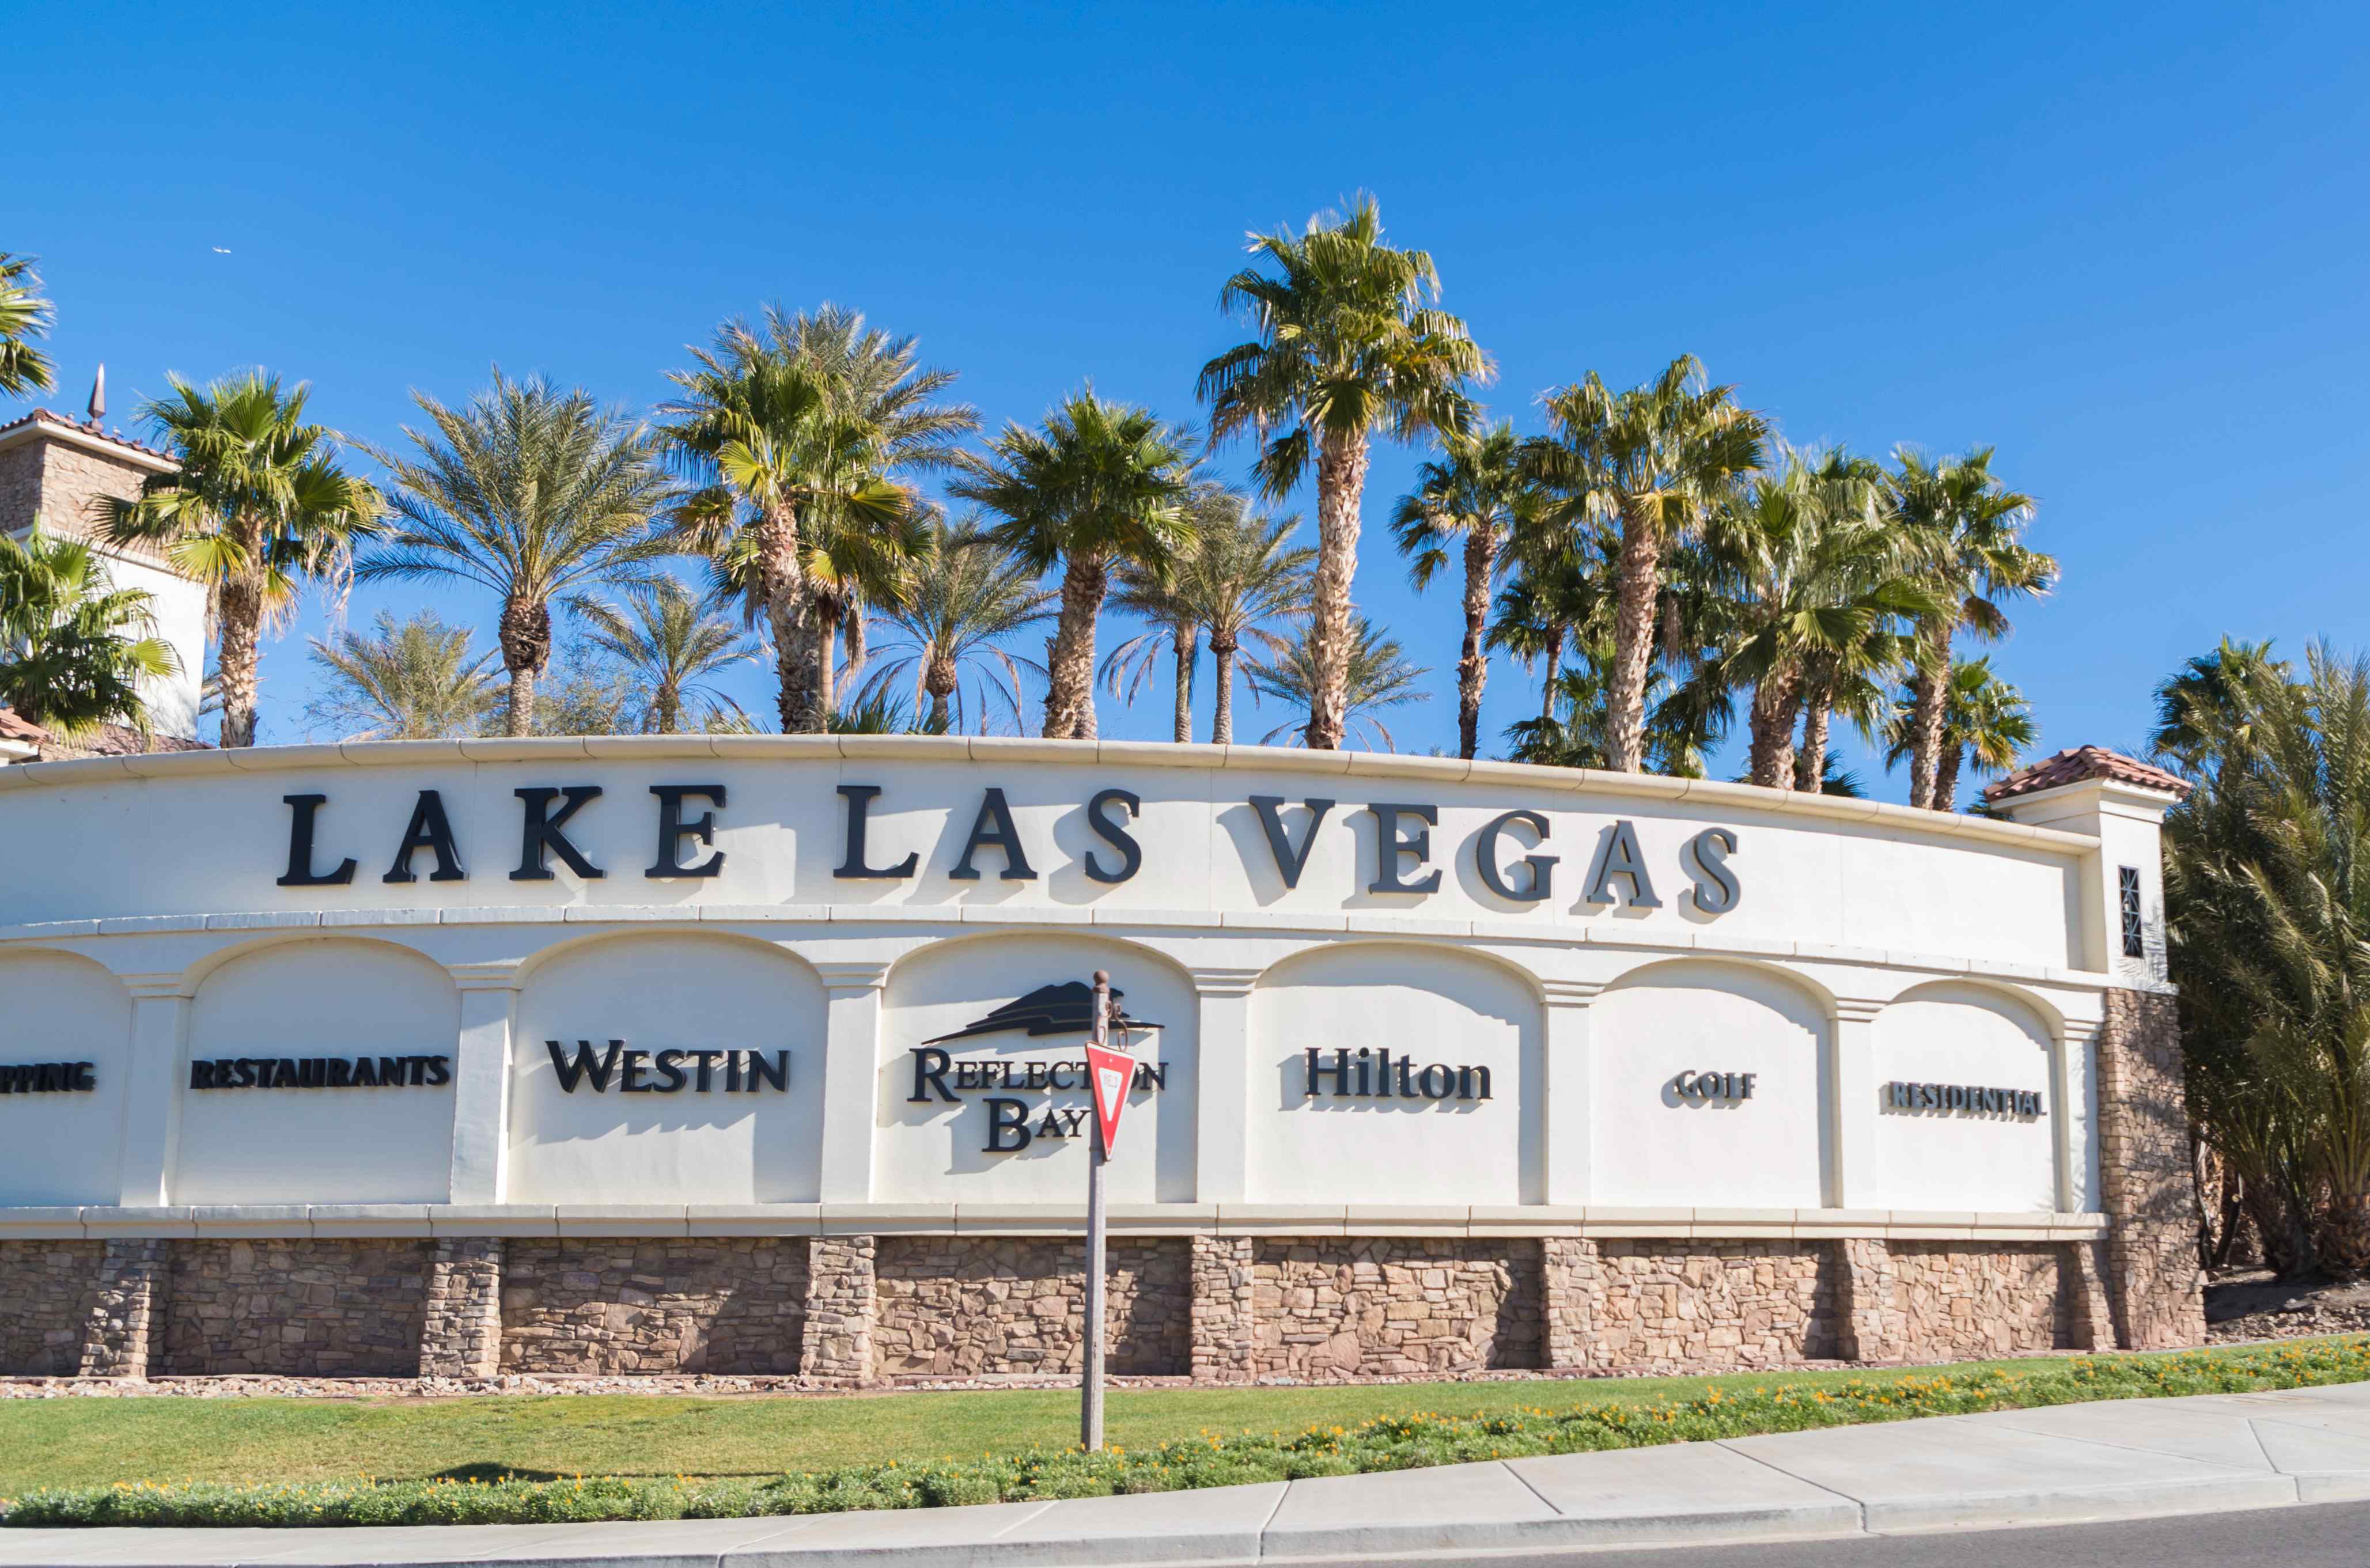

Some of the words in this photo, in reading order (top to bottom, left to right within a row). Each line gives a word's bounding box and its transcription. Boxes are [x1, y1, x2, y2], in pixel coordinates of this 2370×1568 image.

[277, 785, 726, 885] LAKE
[833, 785, 1142, 883] LAS
[1248, 796, 1741, 914] VEGAS
[190, 1055, 451, 1090] RESTAURANTS
[544, 1039, 791, 1093] WESTIN
[907, 1048, 1169, 1102] REFLECTN
[1304, 1047, 1493, 1100] Hilton
[1676, 1070, 1757, 1099] GOLF
[1889, 1081, 2047, 1116] RESIDENTIAL
[982, 1098, 1092, 1153] BAY
